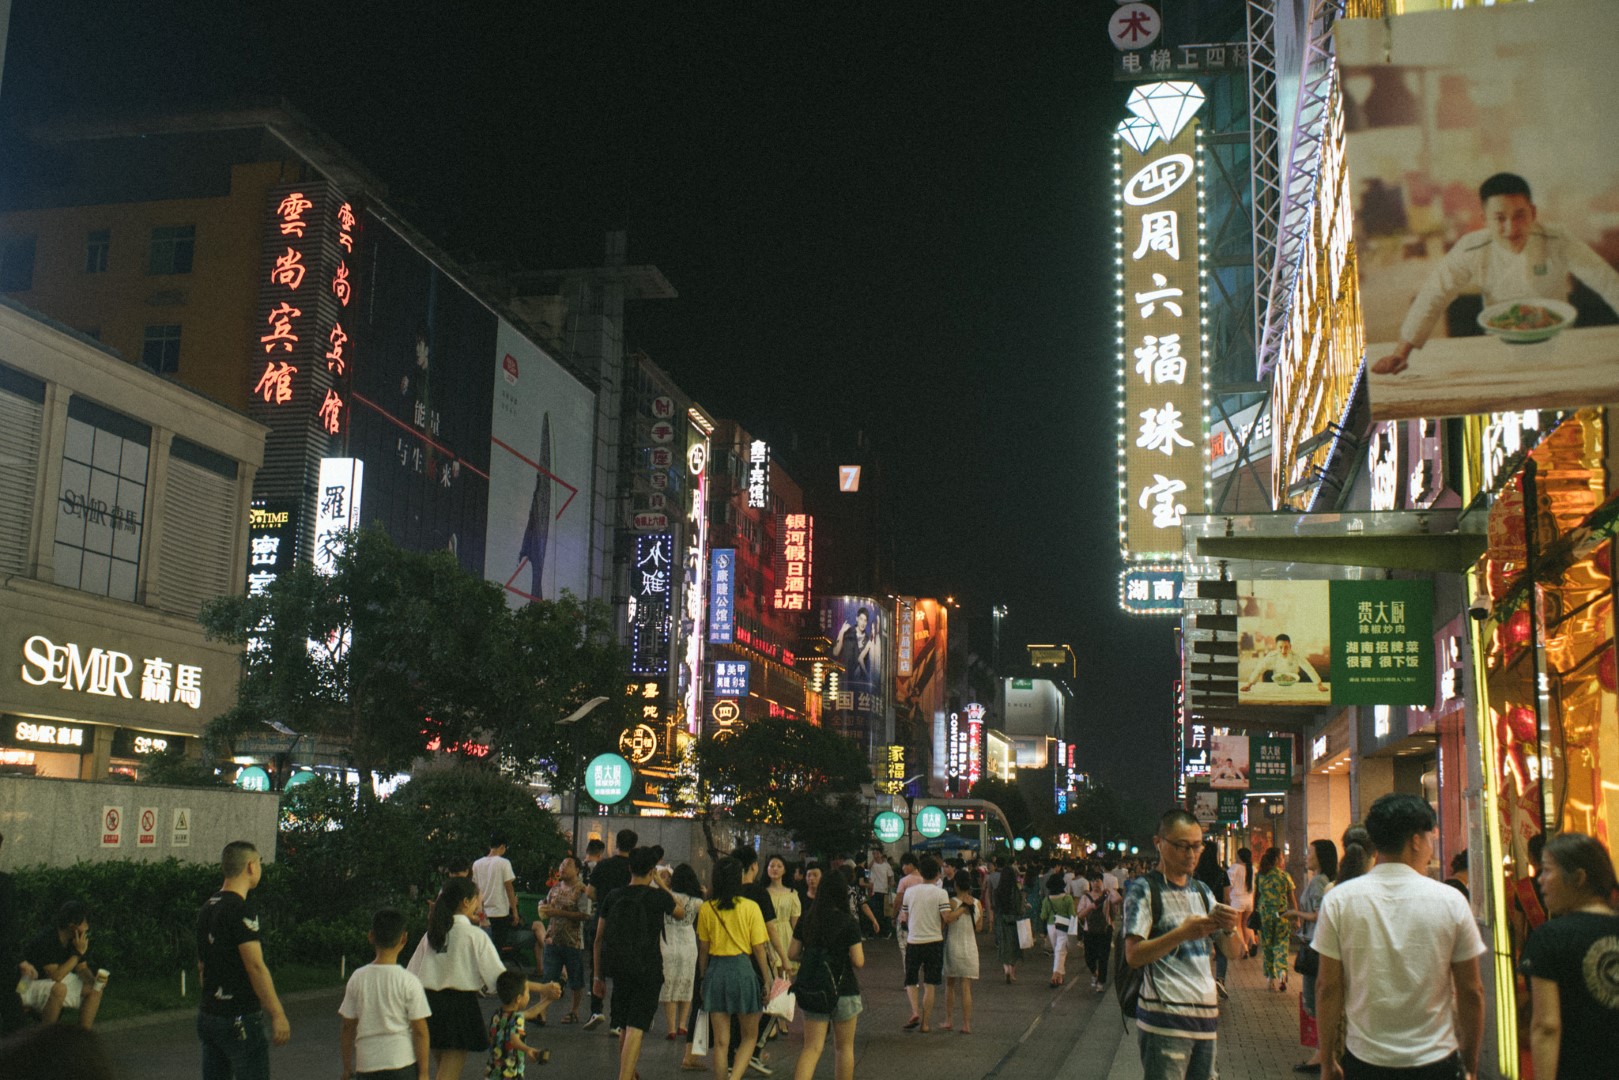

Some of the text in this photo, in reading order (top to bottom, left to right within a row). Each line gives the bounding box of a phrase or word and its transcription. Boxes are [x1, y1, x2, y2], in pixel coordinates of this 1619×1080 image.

[1118, 11, 1151, 42] 术
[254, 192, 313, 405] 雲尚宾馆
[318, 202, 357, 436] 雲尚宾馆
[1132, 209, 1194, 530] 周六福珠宝
[841, 467, 858, 490] 7
[63, 489, 108, 527] SEMIR
[783, 513, 807, 610] 银河假日酒店
[1127, 578, 1185, 601] 湖南
[1358, 601, 1405, 624] 费大厨
[1359, 624, 1406, 635] 辣椒炒肉
[1346, 641, 1419, 654] 湖南招牌菜
[1346, 655, 1419, 668] 很香 很下饭
[21, 634, 204, 710] SEMIR 森馬
[951, 713, 959, 767] CONVERSE
